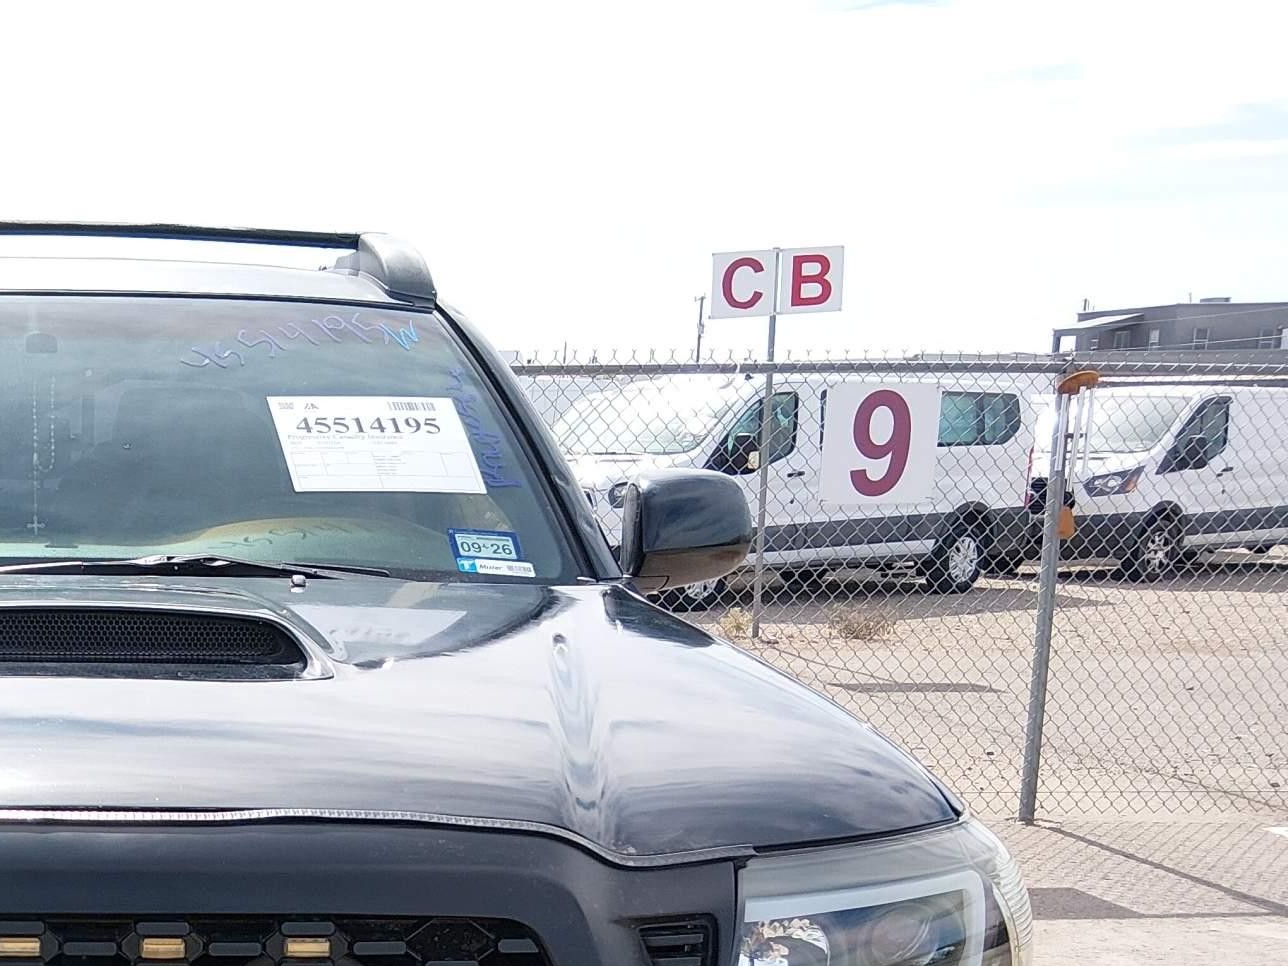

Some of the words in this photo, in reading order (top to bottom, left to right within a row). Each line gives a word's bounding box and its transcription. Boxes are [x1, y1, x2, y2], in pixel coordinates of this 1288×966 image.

[721, 257, 765, 309] C
[790, 254, 832, 307] B
[296, 417, 441, 434] 45514195
[849, 389, 912, 497] 9
[460, 541, 482, 554] 09
[490, 543, 513, 555] 26
